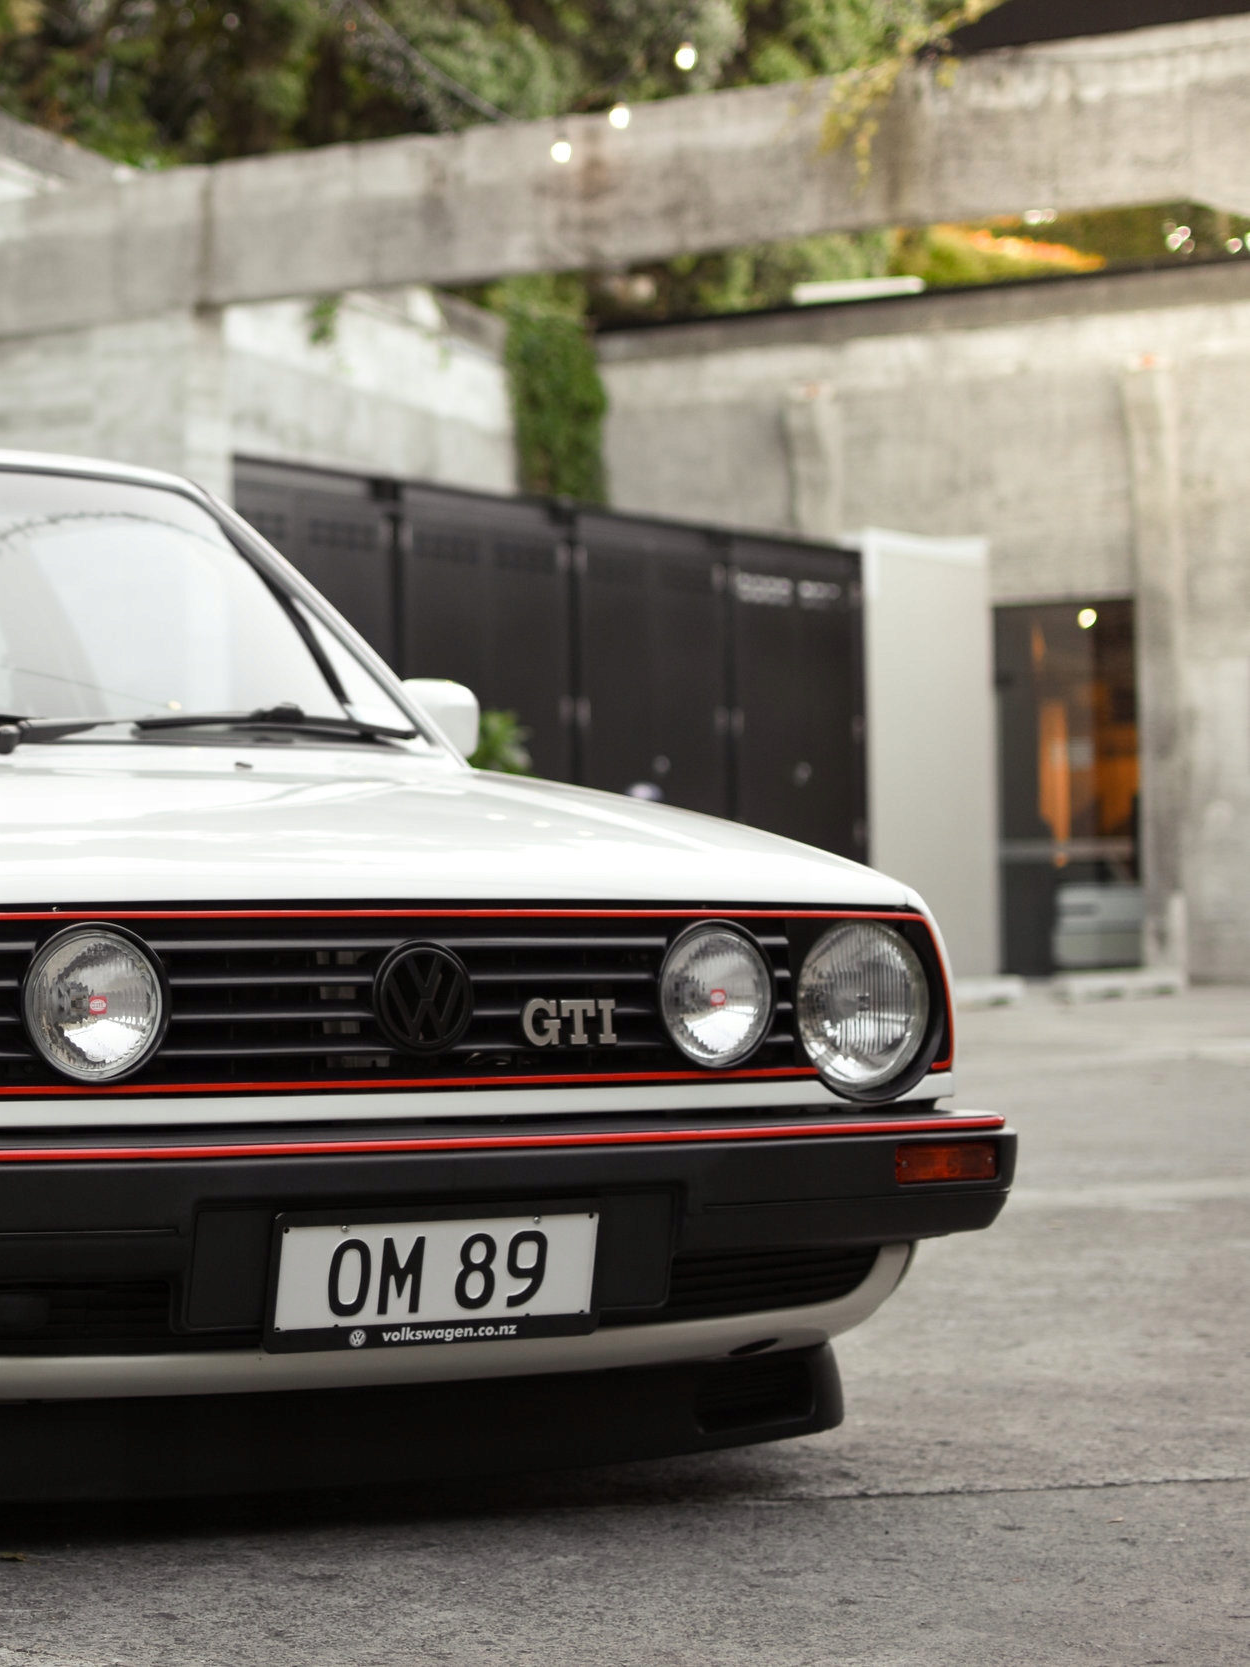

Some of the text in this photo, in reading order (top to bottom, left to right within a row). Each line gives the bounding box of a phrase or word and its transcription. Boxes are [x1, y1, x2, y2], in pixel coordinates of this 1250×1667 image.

[521, 997, 618, 1047] GTI
[327, 1229, 549, 1317] OM 89
[381, 1324, 518, 1342] volkswagen.co.nz
